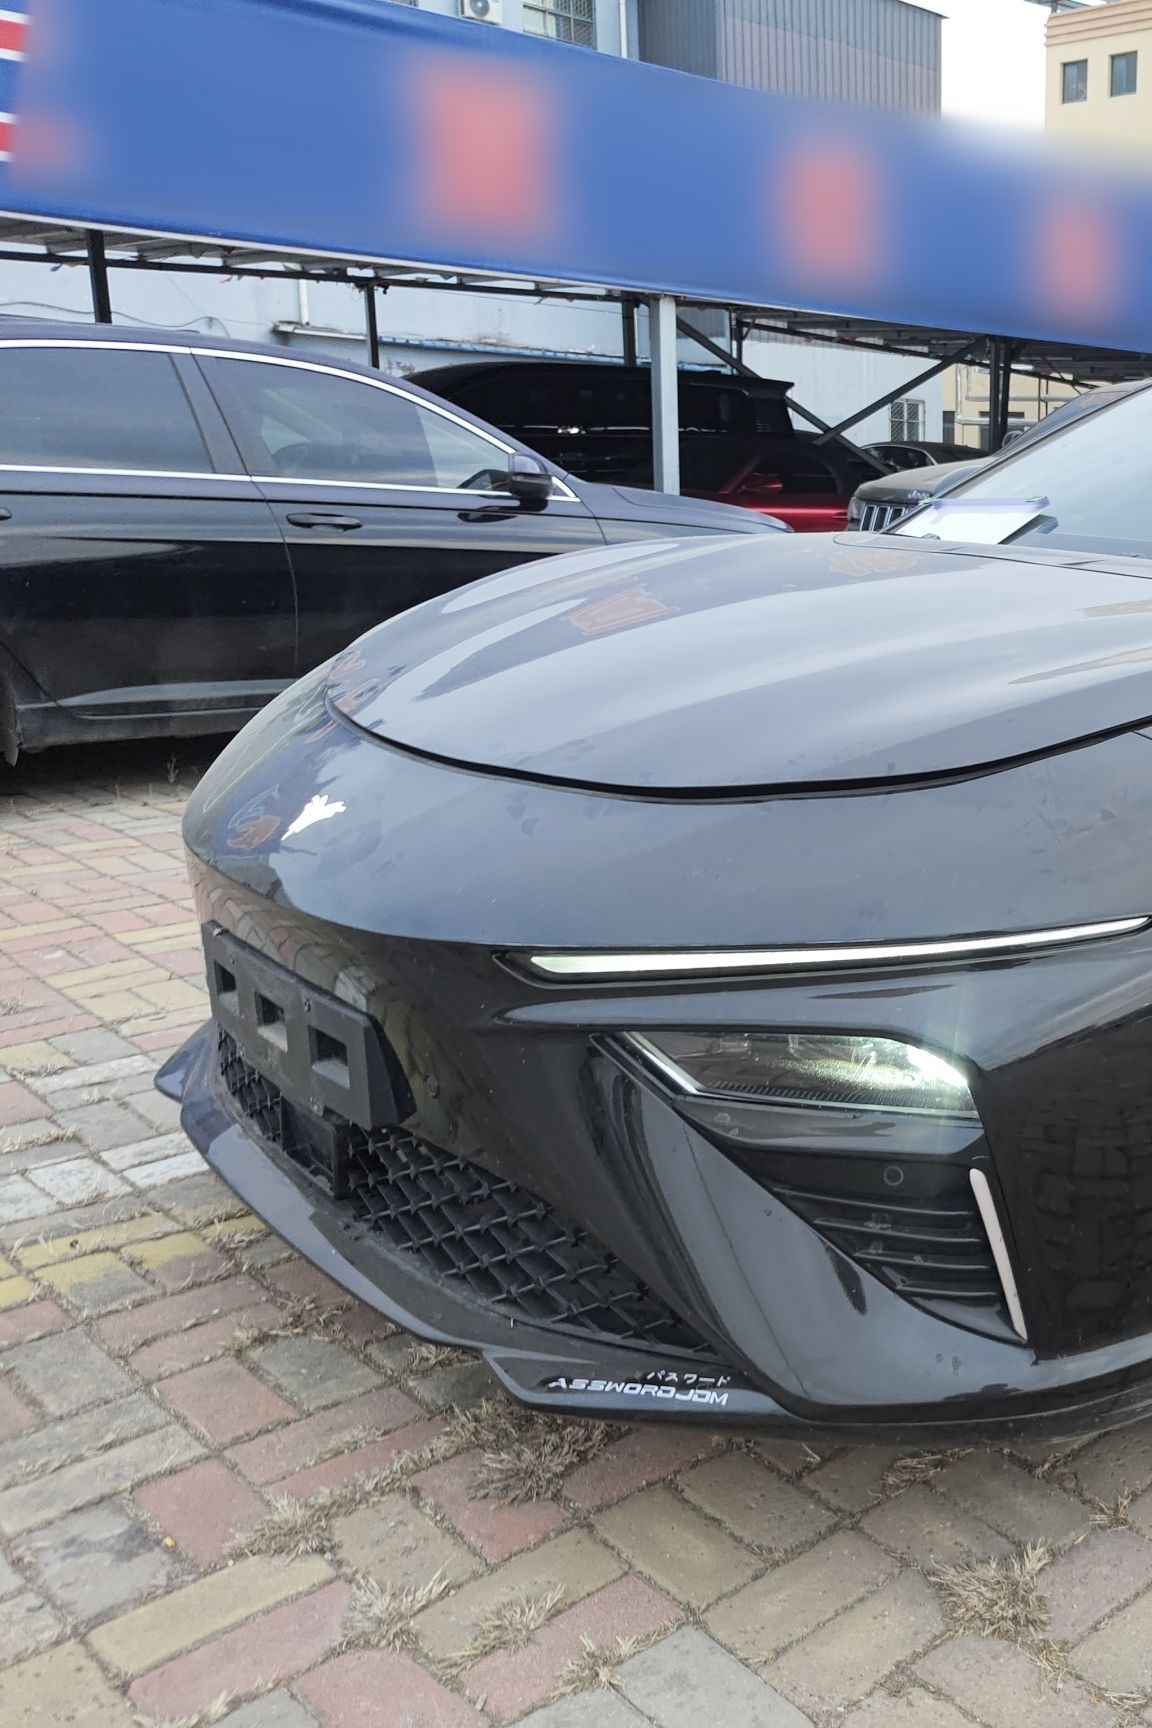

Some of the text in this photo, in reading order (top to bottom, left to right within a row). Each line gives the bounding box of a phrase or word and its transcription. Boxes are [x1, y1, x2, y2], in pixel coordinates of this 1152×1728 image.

[646, 1369, 731, 1387] パスワード
